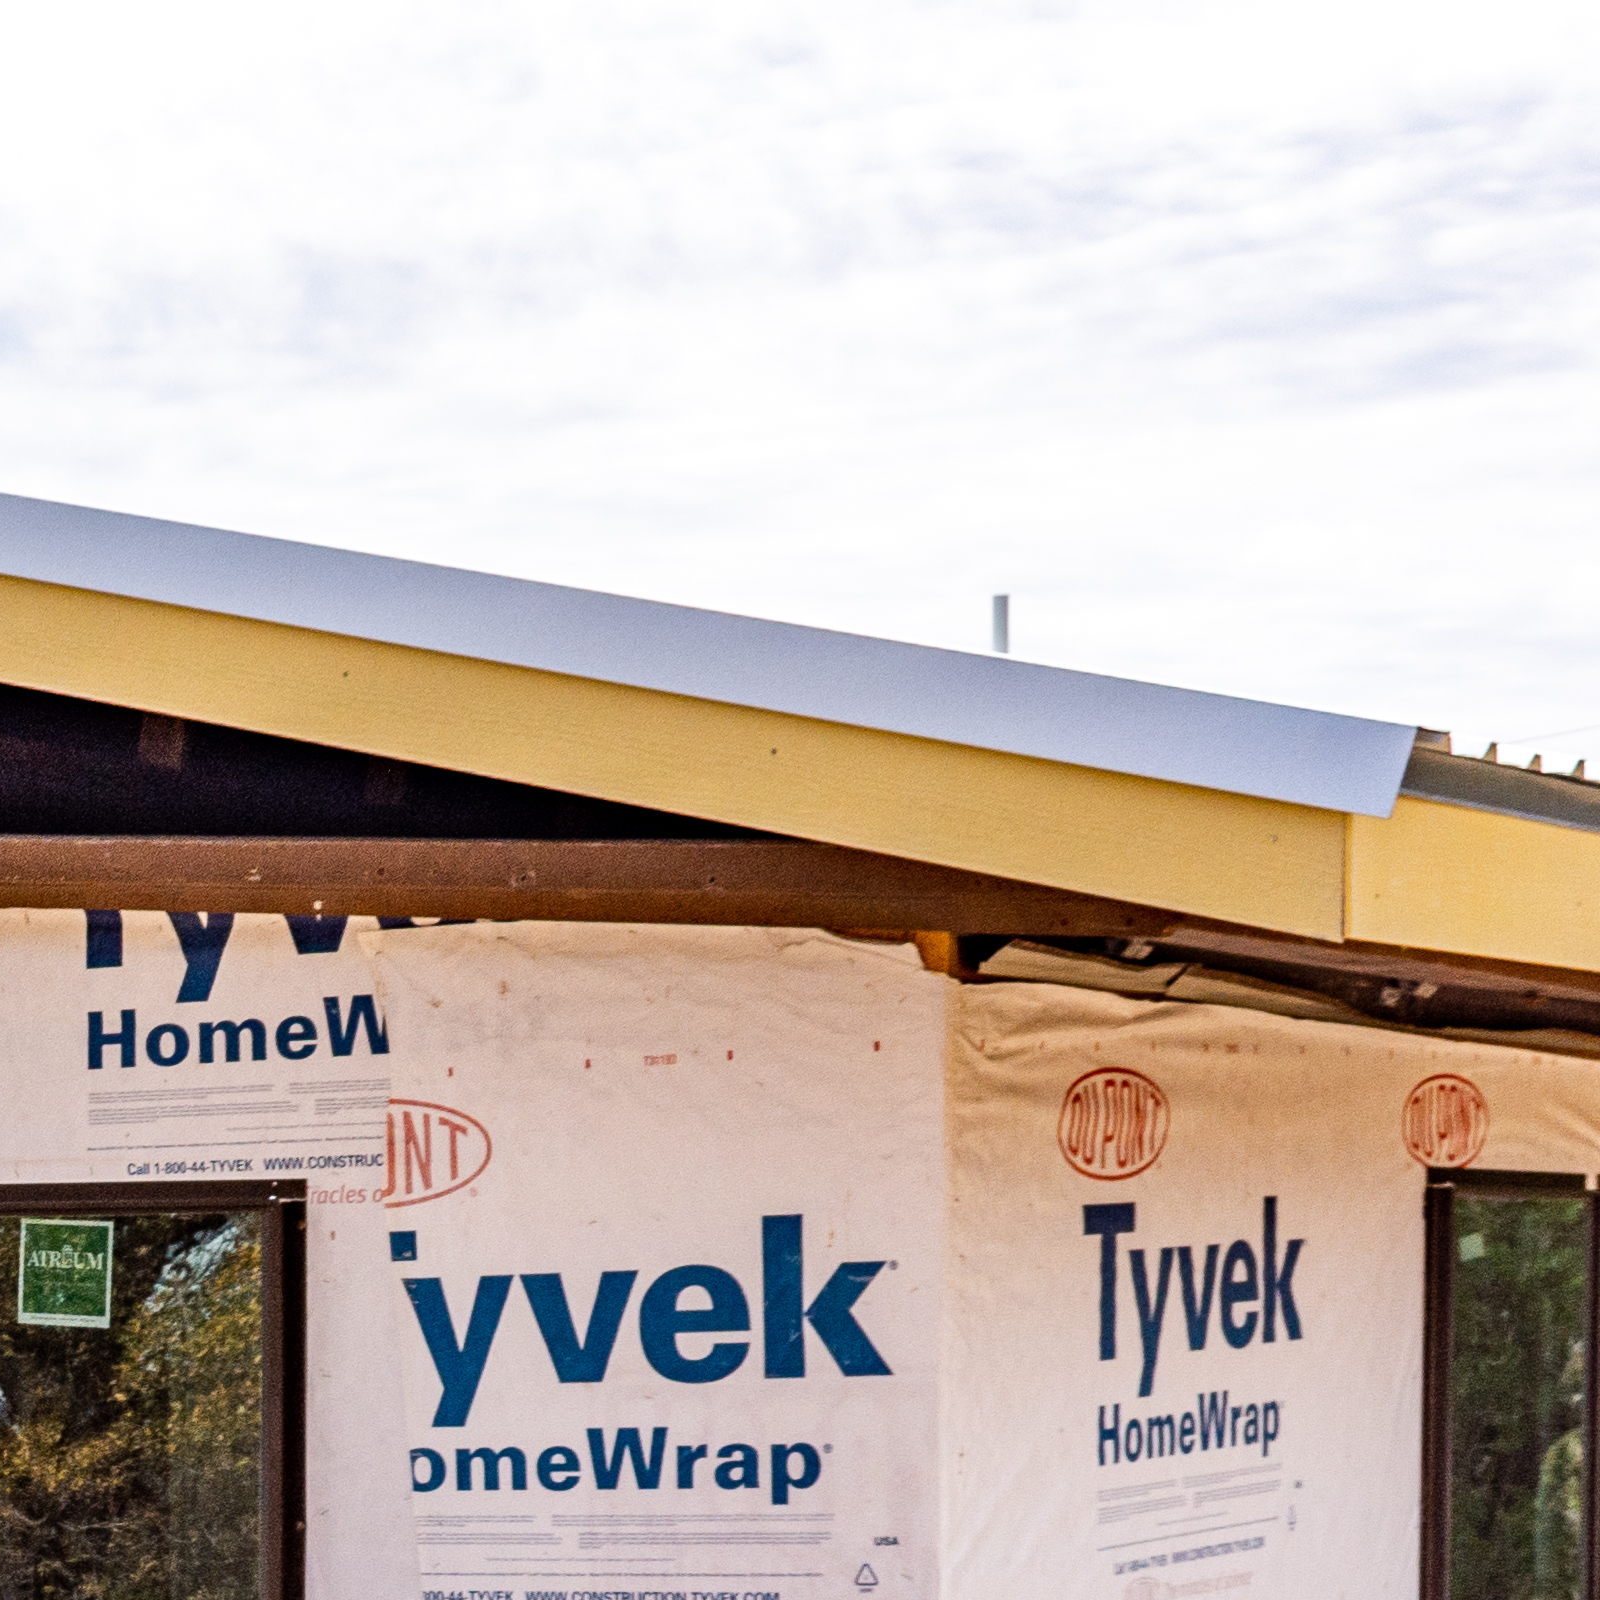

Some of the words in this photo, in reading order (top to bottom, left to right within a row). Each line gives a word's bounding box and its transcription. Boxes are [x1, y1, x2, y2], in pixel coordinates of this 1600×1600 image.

[127, 1162, 150, 1176] Call
[154, 1158, 254, 1175] 1-800-44-TYVEK
[390, 1213, 893, 1427] yvek
[1082, 1196, 1306, 1397] Tyvek
[1097, 1390, 1280, 1467] HomeWrap
